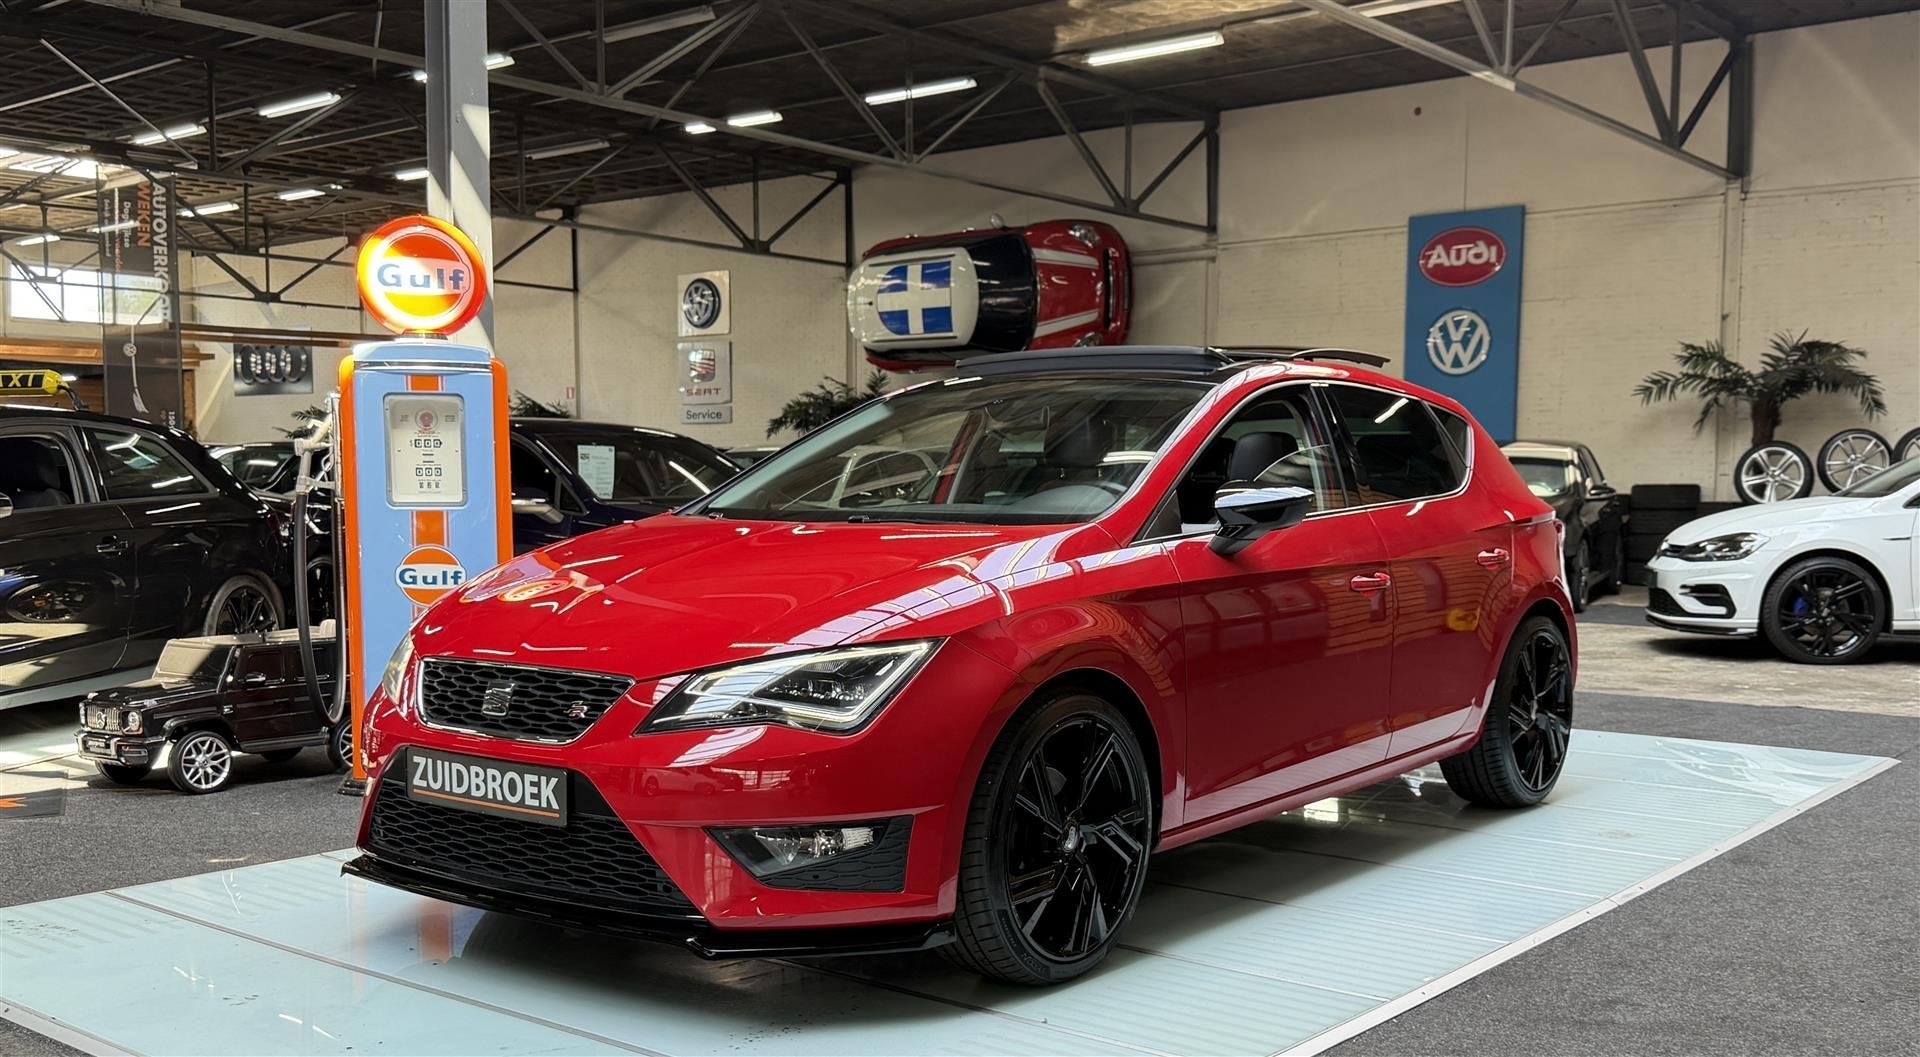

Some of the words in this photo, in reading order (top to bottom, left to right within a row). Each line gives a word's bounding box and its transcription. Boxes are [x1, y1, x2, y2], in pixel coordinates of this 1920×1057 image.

[137, 182, 151, 247] WEKEN
[377, 263, 465, 290] Gulf
[686, 387, 722, 397] SEAT
[686, 409, 723, 421] Service
[398, 568, 462, 585] Gulf
[412, 755, 560, 810] ZUIDBROEK
